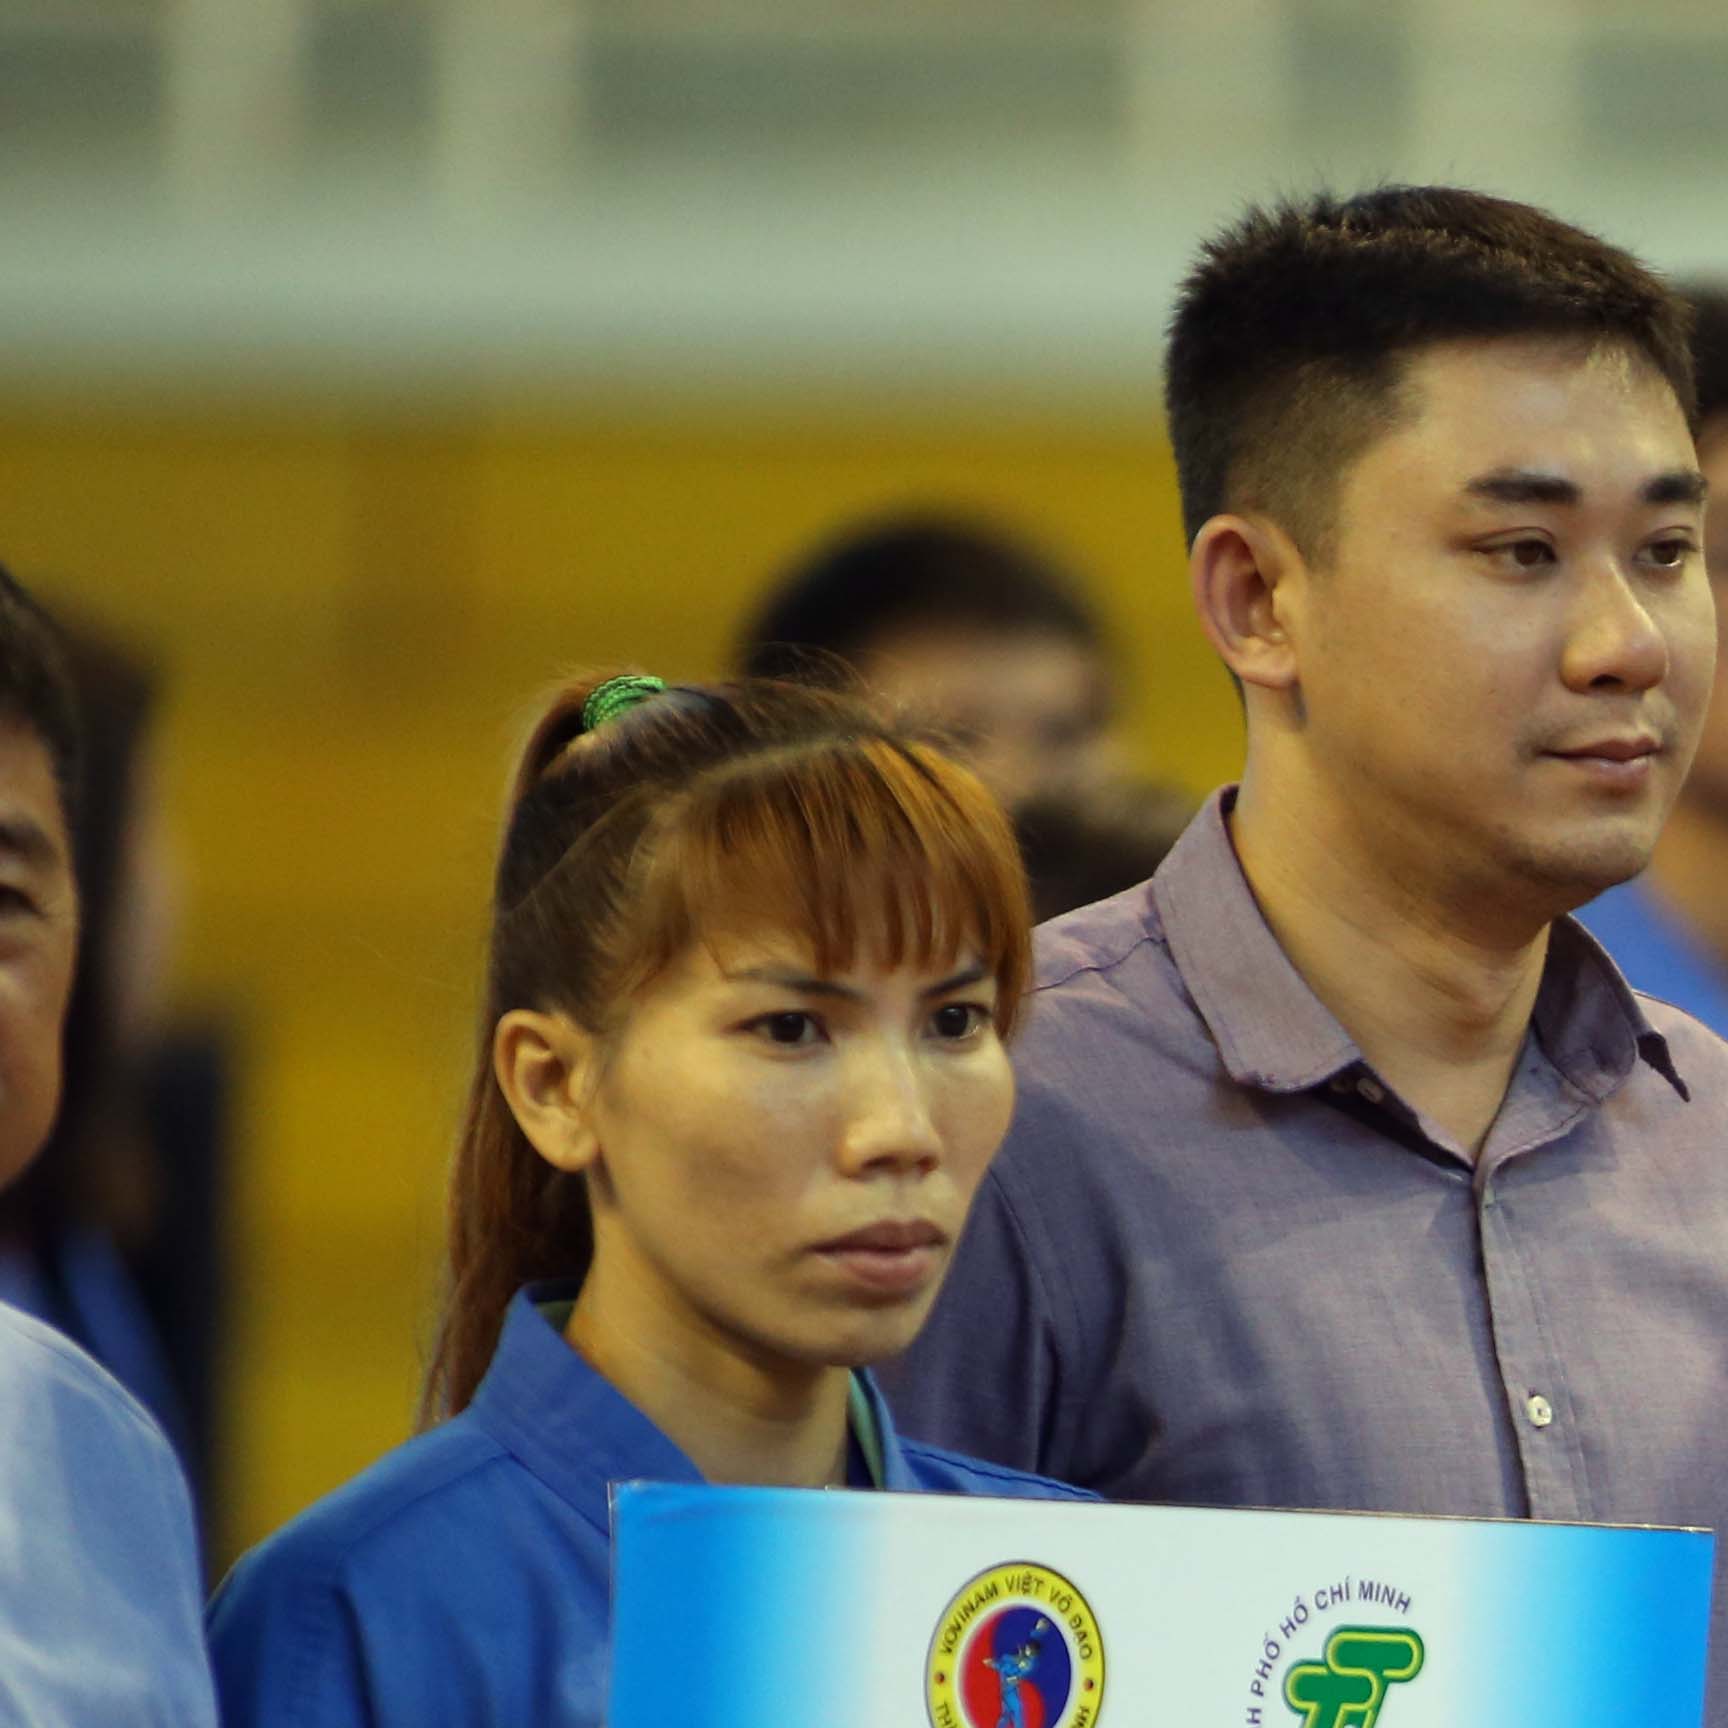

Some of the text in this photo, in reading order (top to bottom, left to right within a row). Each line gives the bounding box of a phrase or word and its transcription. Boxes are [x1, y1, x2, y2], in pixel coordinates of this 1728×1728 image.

[941, 1581, 999, 1655] VOVINAM
[1005, 1572, 1044, 1595] VIỆT
[1251, 1632, 1281, 1697] PHỐ
[1279, 1596, 1309, 1638] HỒ
[1315, 1576, 1350, 1610] CHÍ
[1359, 1580, 1411, 1614] MINH
